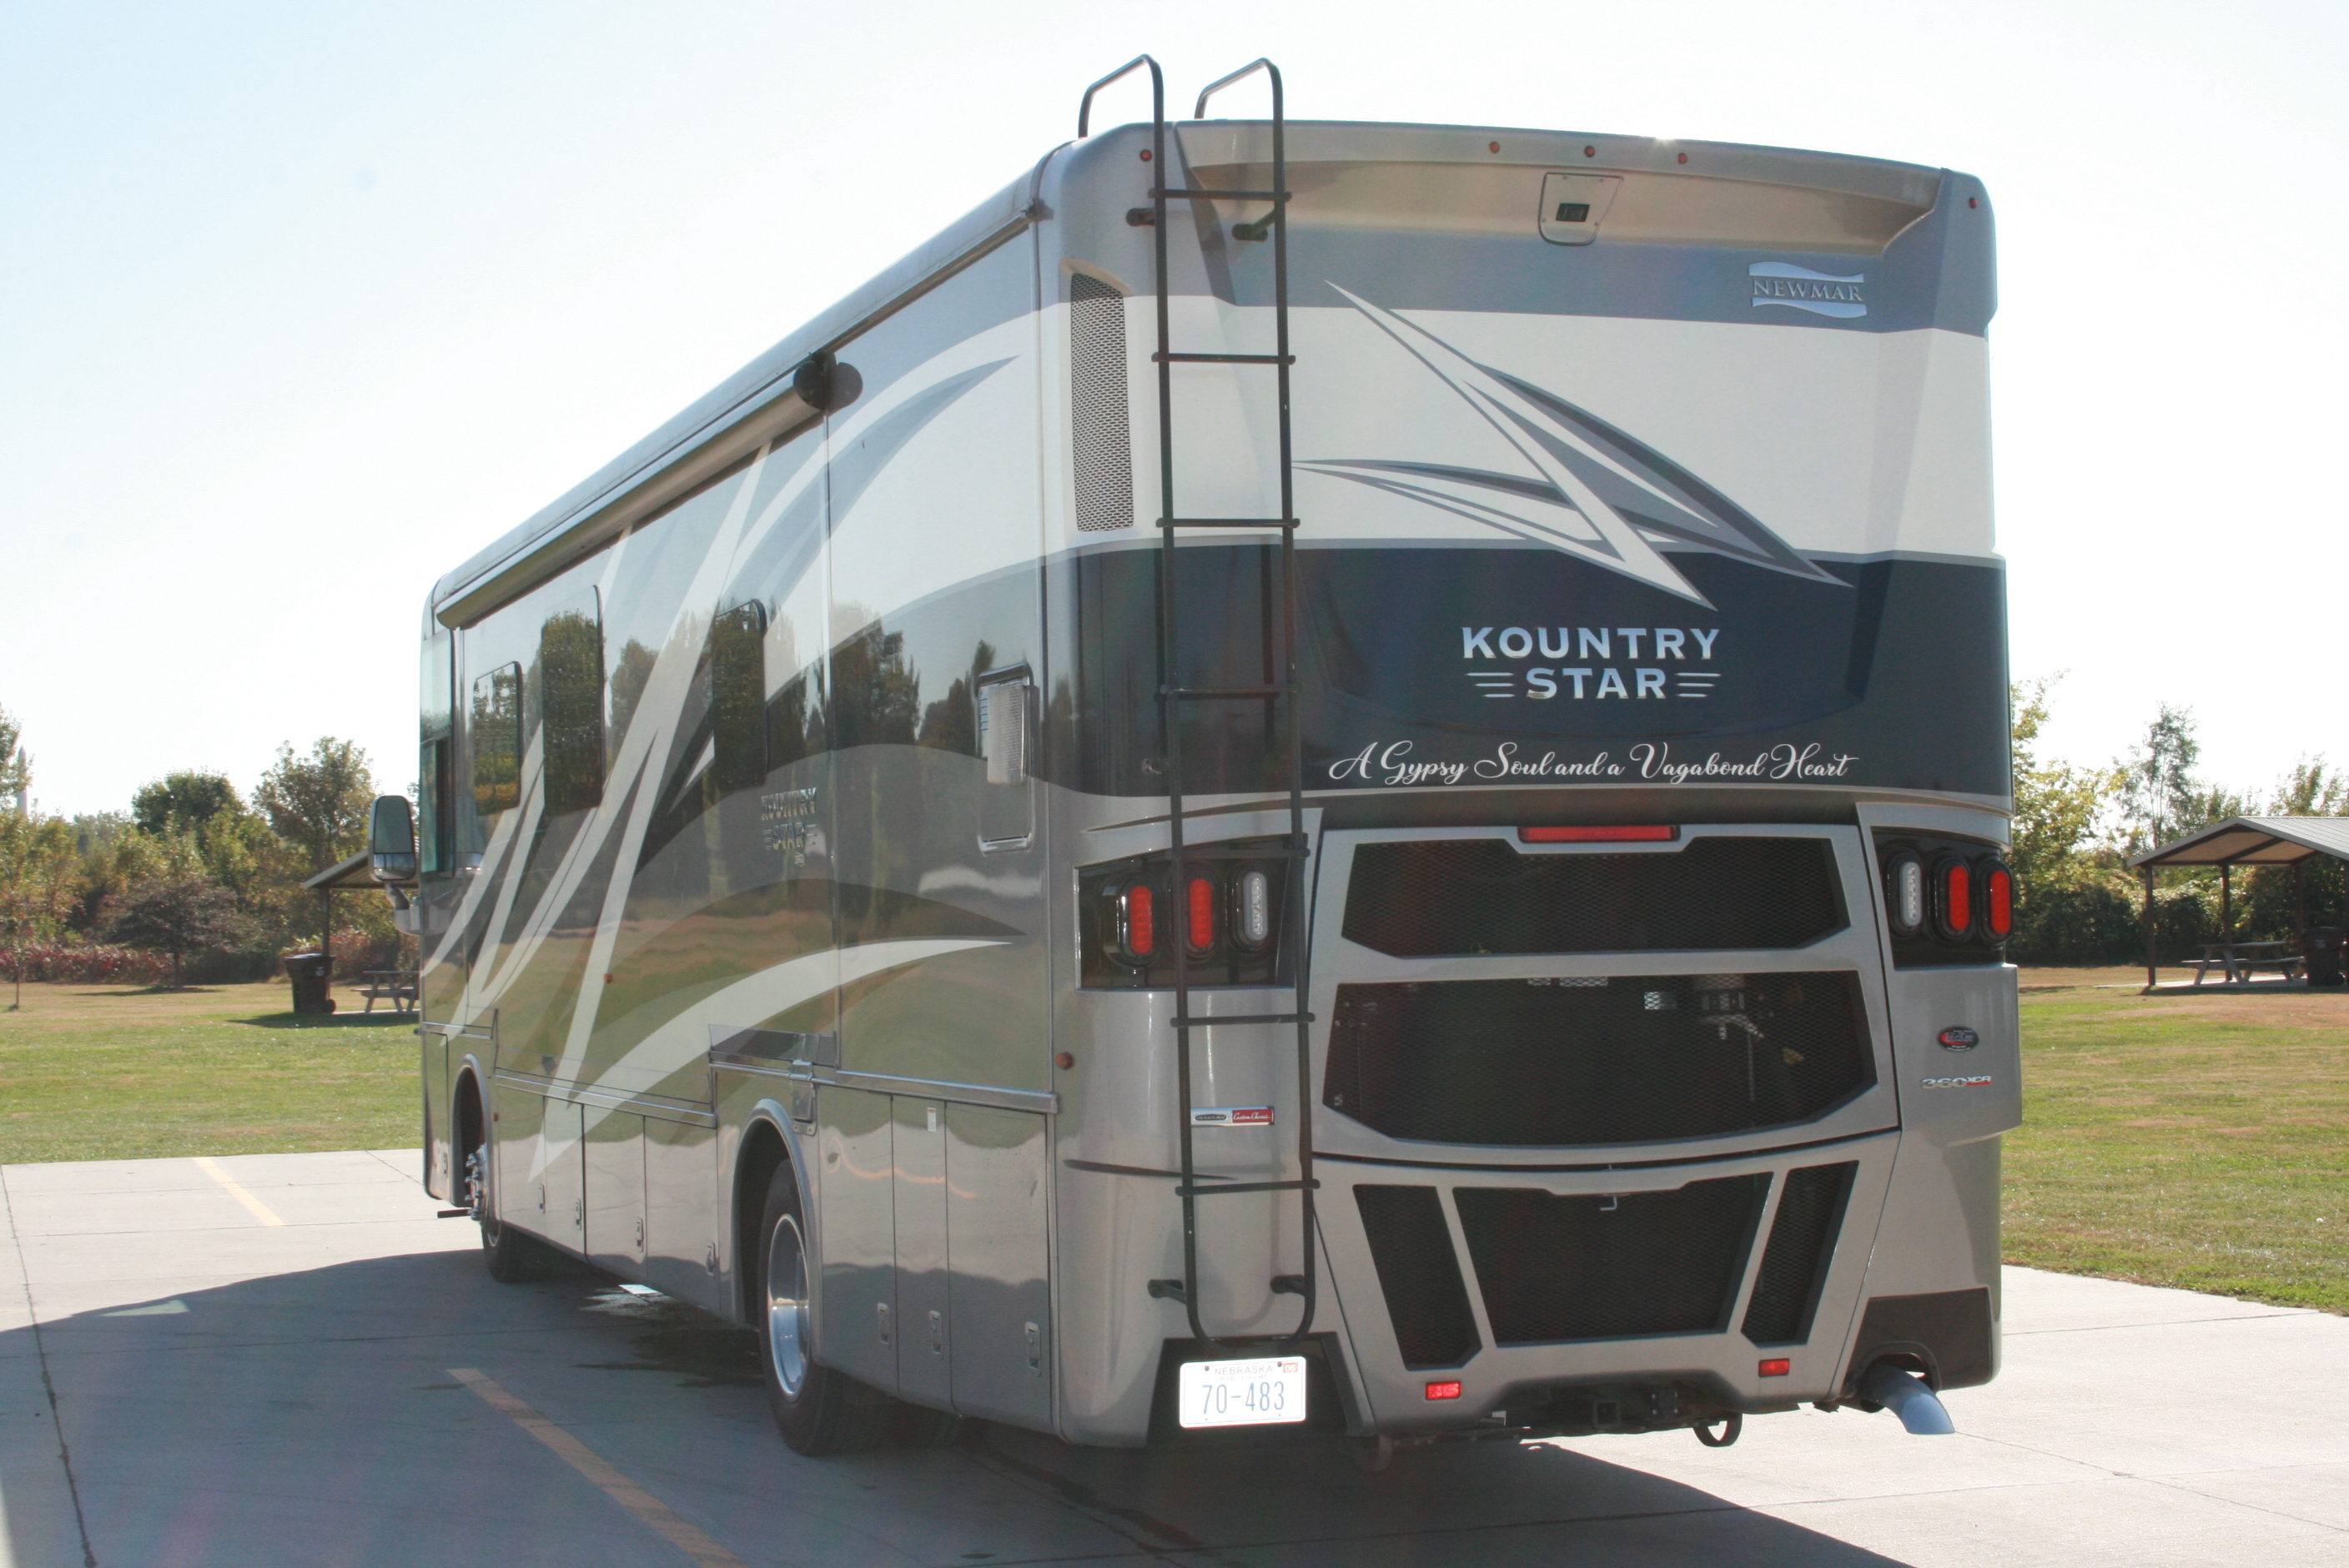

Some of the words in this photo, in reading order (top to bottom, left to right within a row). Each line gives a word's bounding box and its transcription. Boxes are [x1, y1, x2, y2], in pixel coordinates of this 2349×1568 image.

[1753, 279, 1864, 302] NEWMAR
[1461, 626, 1721, 660] KOUNTRY
[1525, 667, 1667, 700] STAR
[1328, 741, 1379, 780] A
[1380, 740, 1470, 786] Gypsy
[1473, 741, 1556, 779] Soul
[1553, 751, 1609, 776] and
[1606, 762, 1626, 776] a
[1629, 741, 1768, 786] Vagabond
[1769, 742, 1860, 780] Heart
[1215, 1364, 1273, 1375] NEBRASKA
[1202, 1380, 1285, 1415] 70-483
